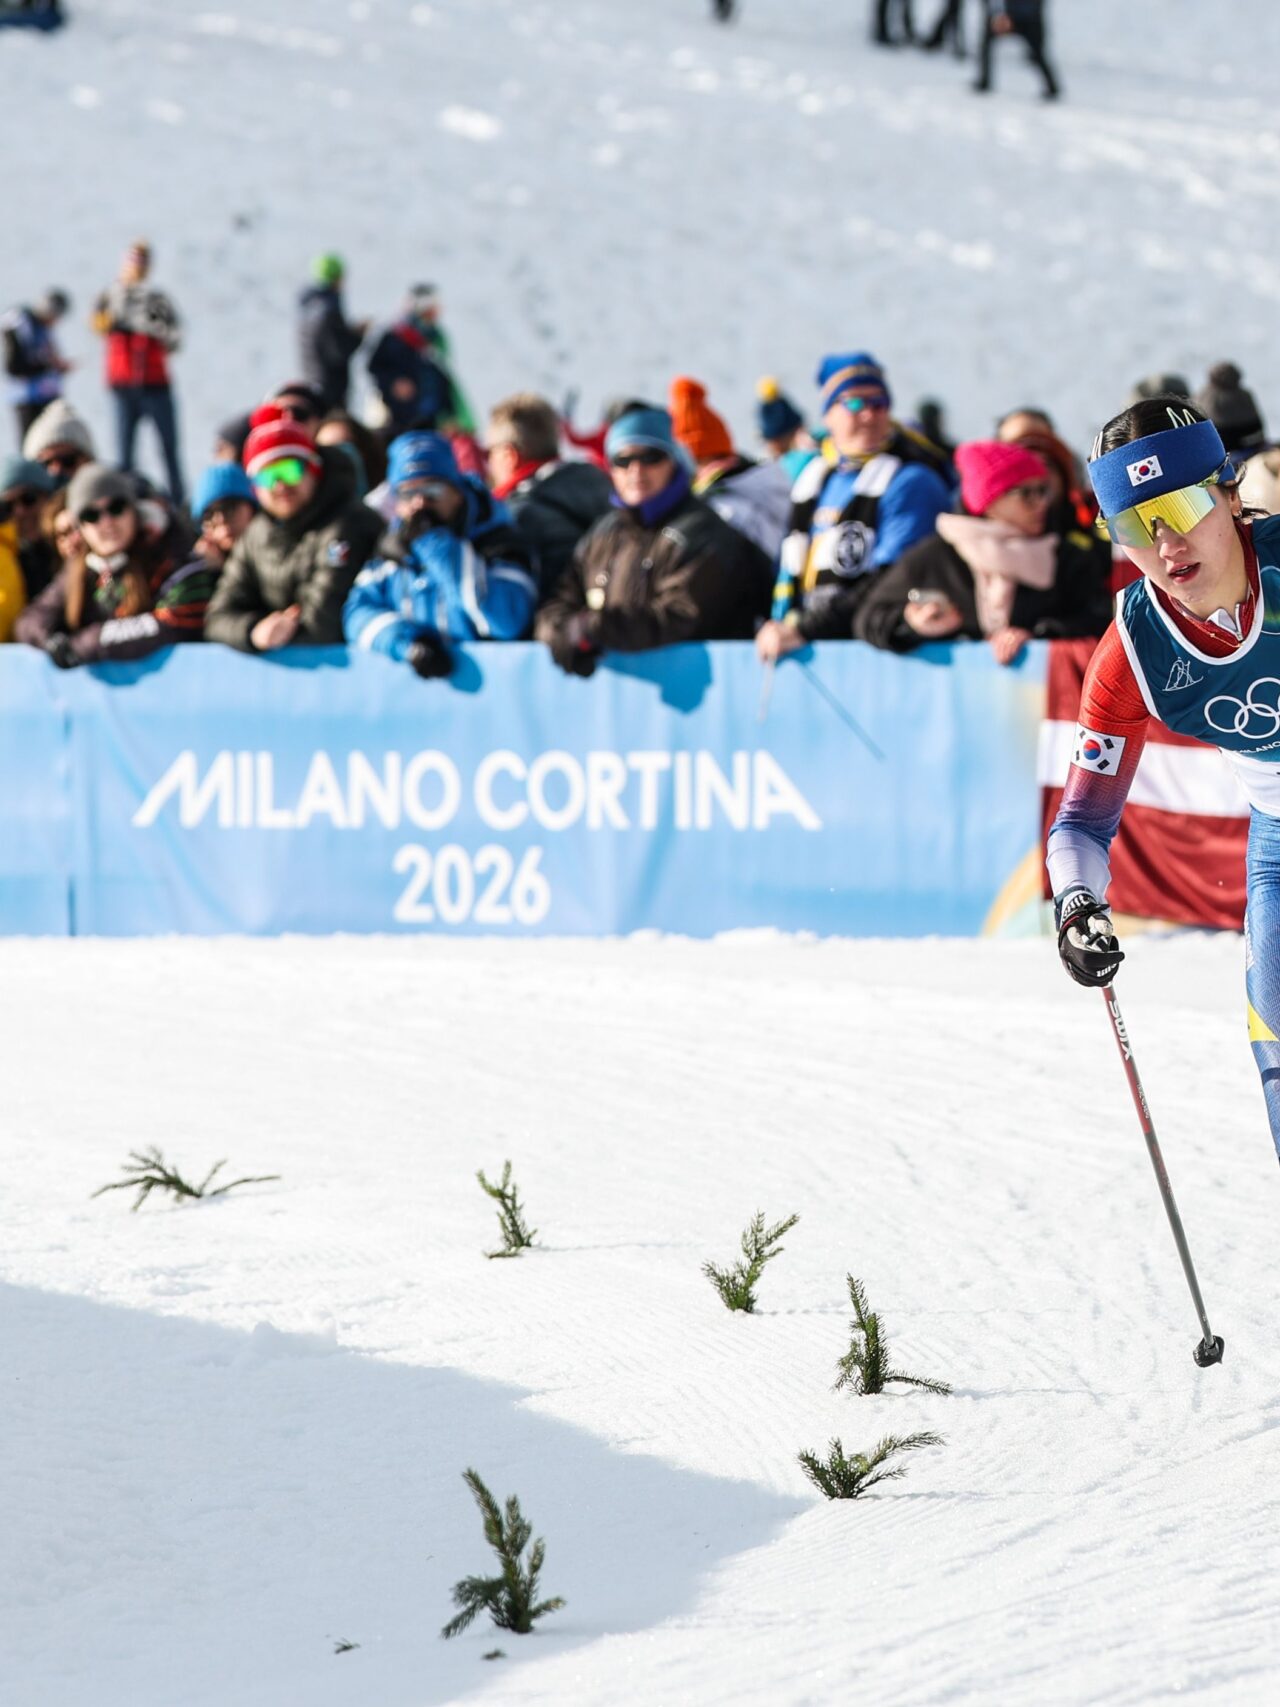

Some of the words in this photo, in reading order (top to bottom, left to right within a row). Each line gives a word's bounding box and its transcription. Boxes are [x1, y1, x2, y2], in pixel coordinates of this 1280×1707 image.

[132, 749, 462, 831] MILANO
[474, 749, 824, 832] CORTINA
[391, 844, 552, 926] 2026
